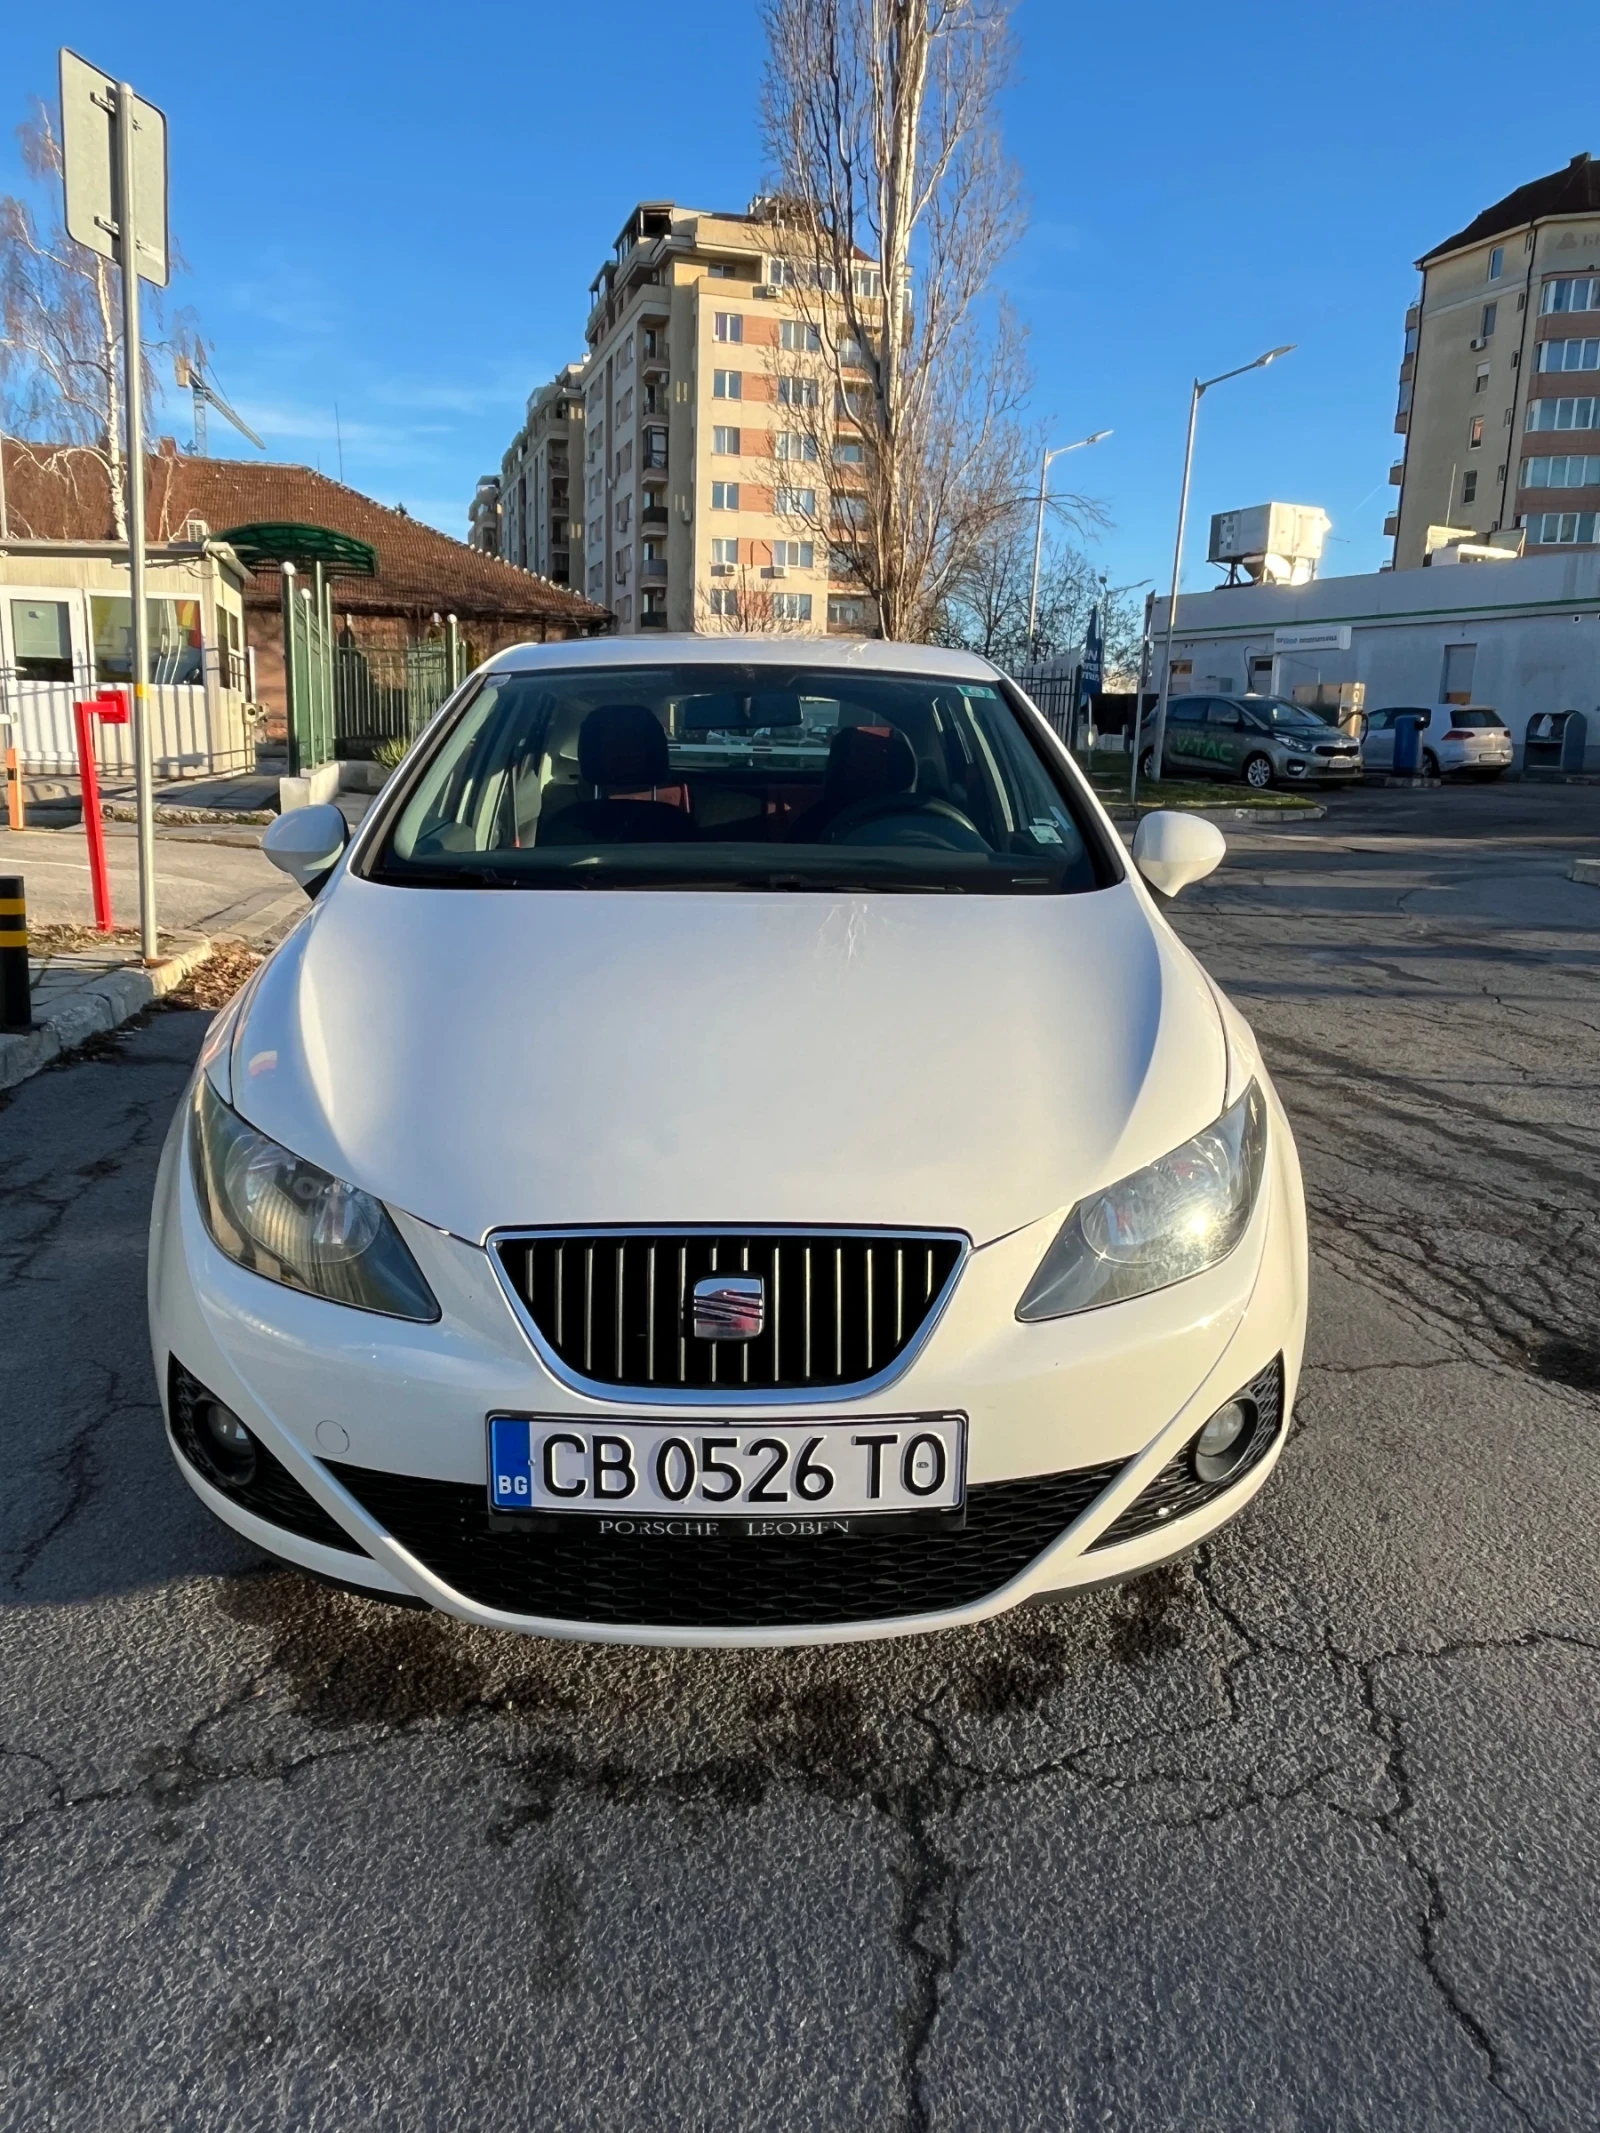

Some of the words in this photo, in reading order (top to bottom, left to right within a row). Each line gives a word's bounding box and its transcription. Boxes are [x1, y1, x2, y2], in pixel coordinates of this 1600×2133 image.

[1176, 733, 1234, 762] V-TAC
[542, 1433, 638, 1500] CB
[655, 1435, 835, 1503] 0526
[498, 1474, 529, 1496] BG
[599, 1519, 720, 1536] PORSCHE
[746, 1519, 850, 1537] LEOBEN
